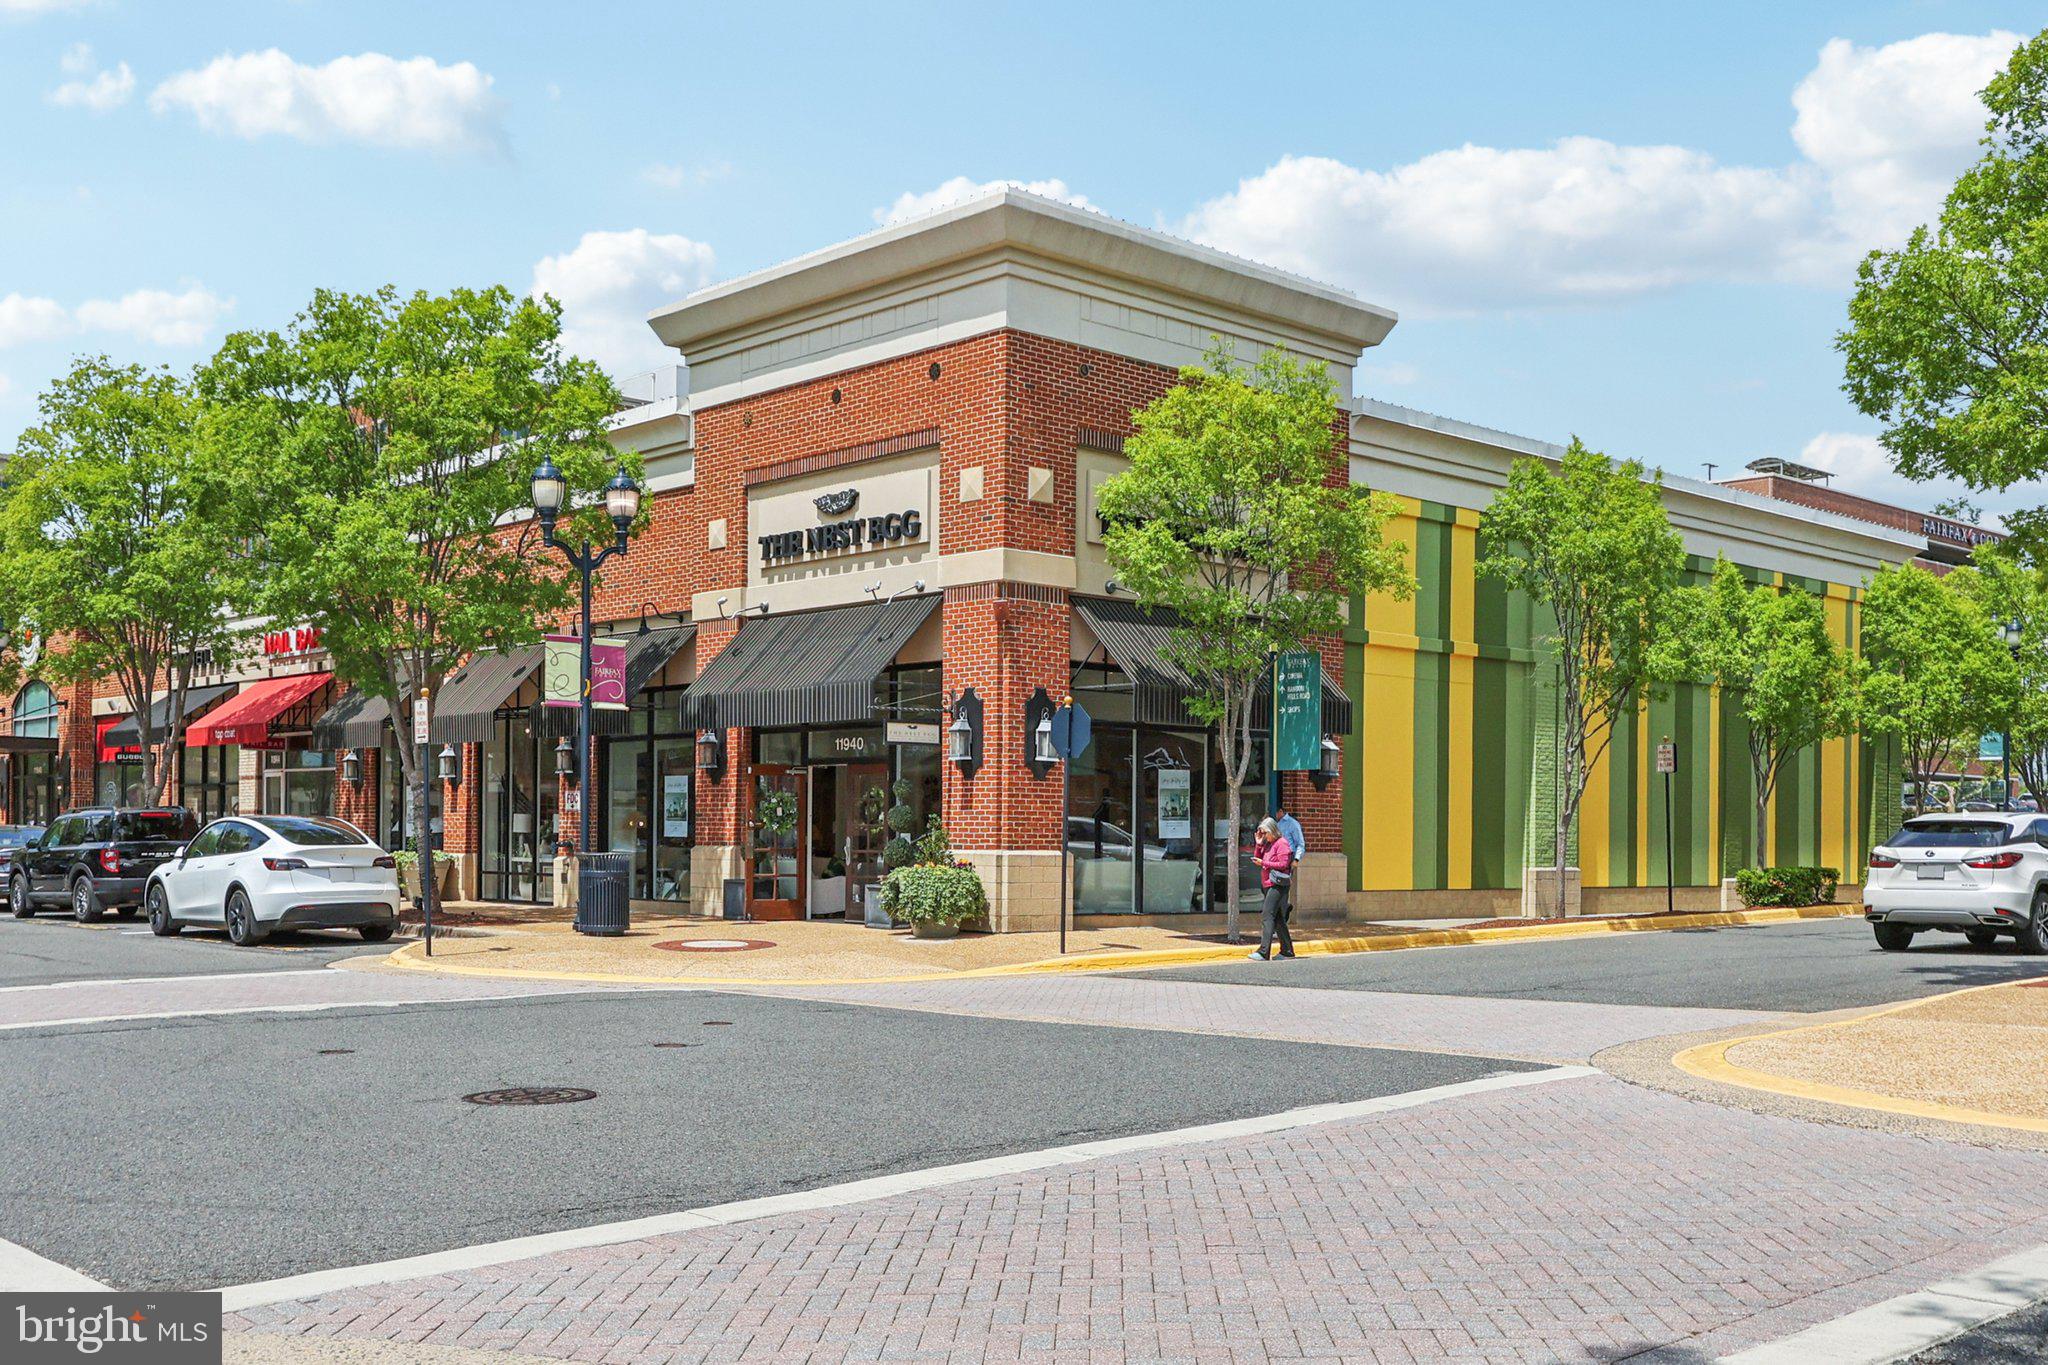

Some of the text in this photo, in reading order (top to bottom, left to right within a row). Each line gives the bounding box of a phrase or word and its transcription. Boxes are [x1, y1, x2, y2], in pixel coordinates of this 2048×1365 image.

[758, 509, 922, 561] THE NEST EGG
[1923, 518, 1968, 543] FAIRFAX
[594, 667, 621, 676] FAIRFAX
[835, 737, 864, 751] 11940
[566, 793, 579, 804] FDC
